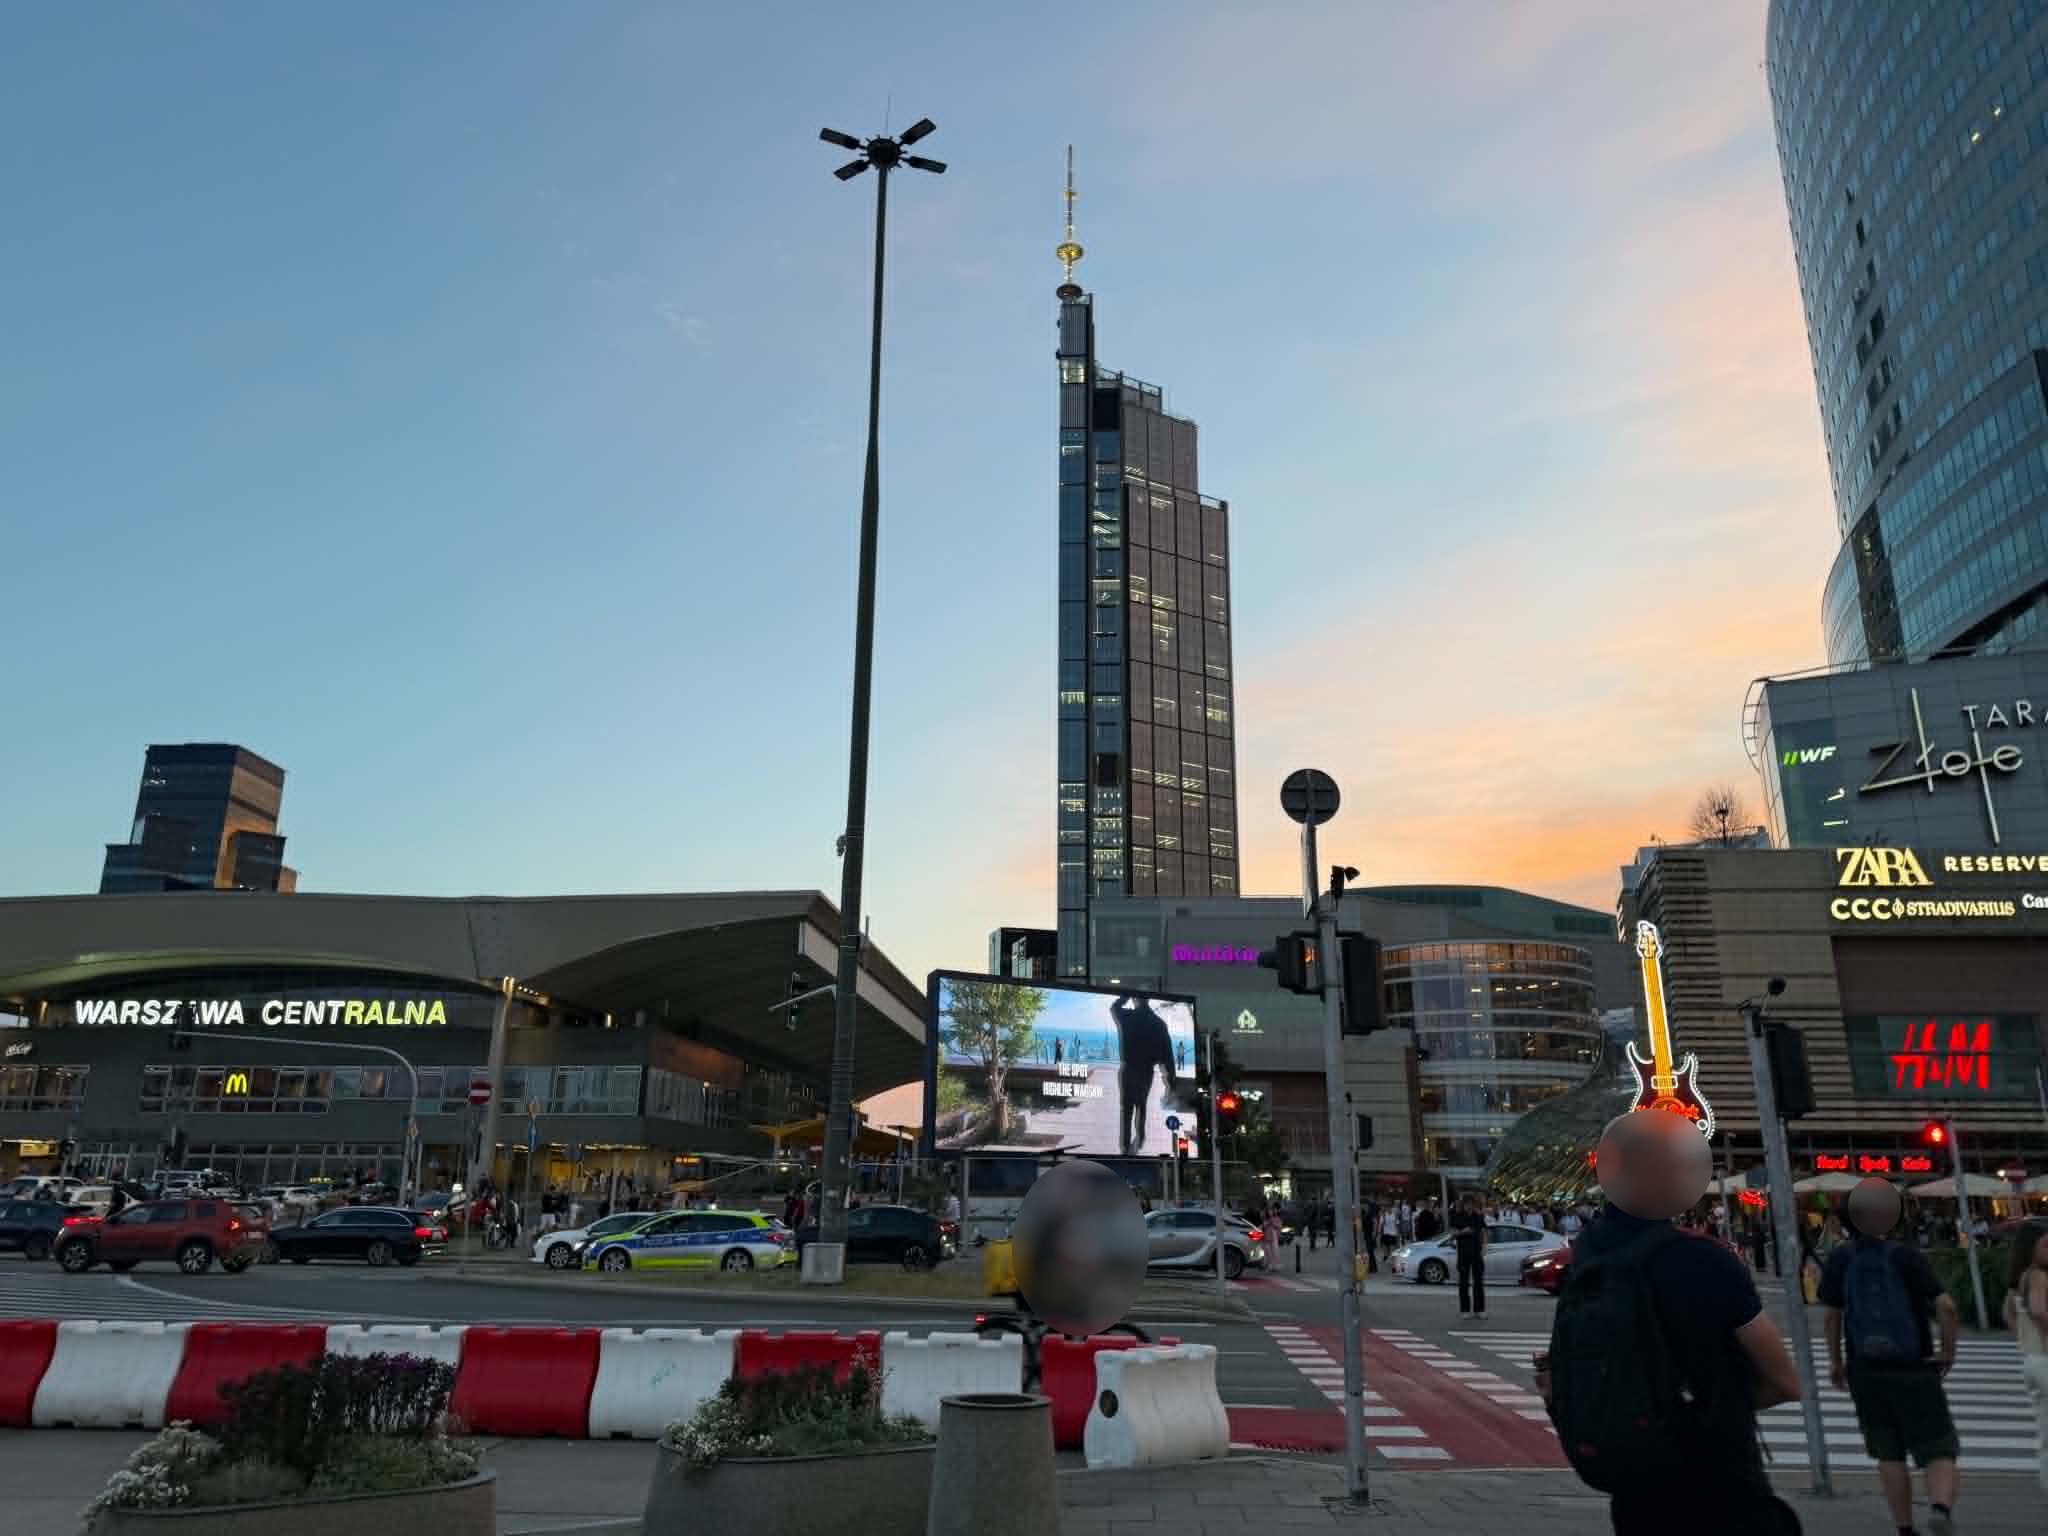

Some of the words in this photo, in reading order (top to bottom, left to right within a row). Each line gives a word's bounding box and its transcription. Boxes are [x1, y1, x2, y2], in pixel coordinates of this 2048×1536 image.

[1836, 847, 1935, 887] ZARA
[1943, 855, 2048, 872] RESERVE
[1831, 898, 1891, 920] CCC
[1906, 901, 2016, 917] STRADIVARIUS
[262, 1000, 447, 1025] CENTRALNA
[1891, 1022, 1991, 1089] H&M
